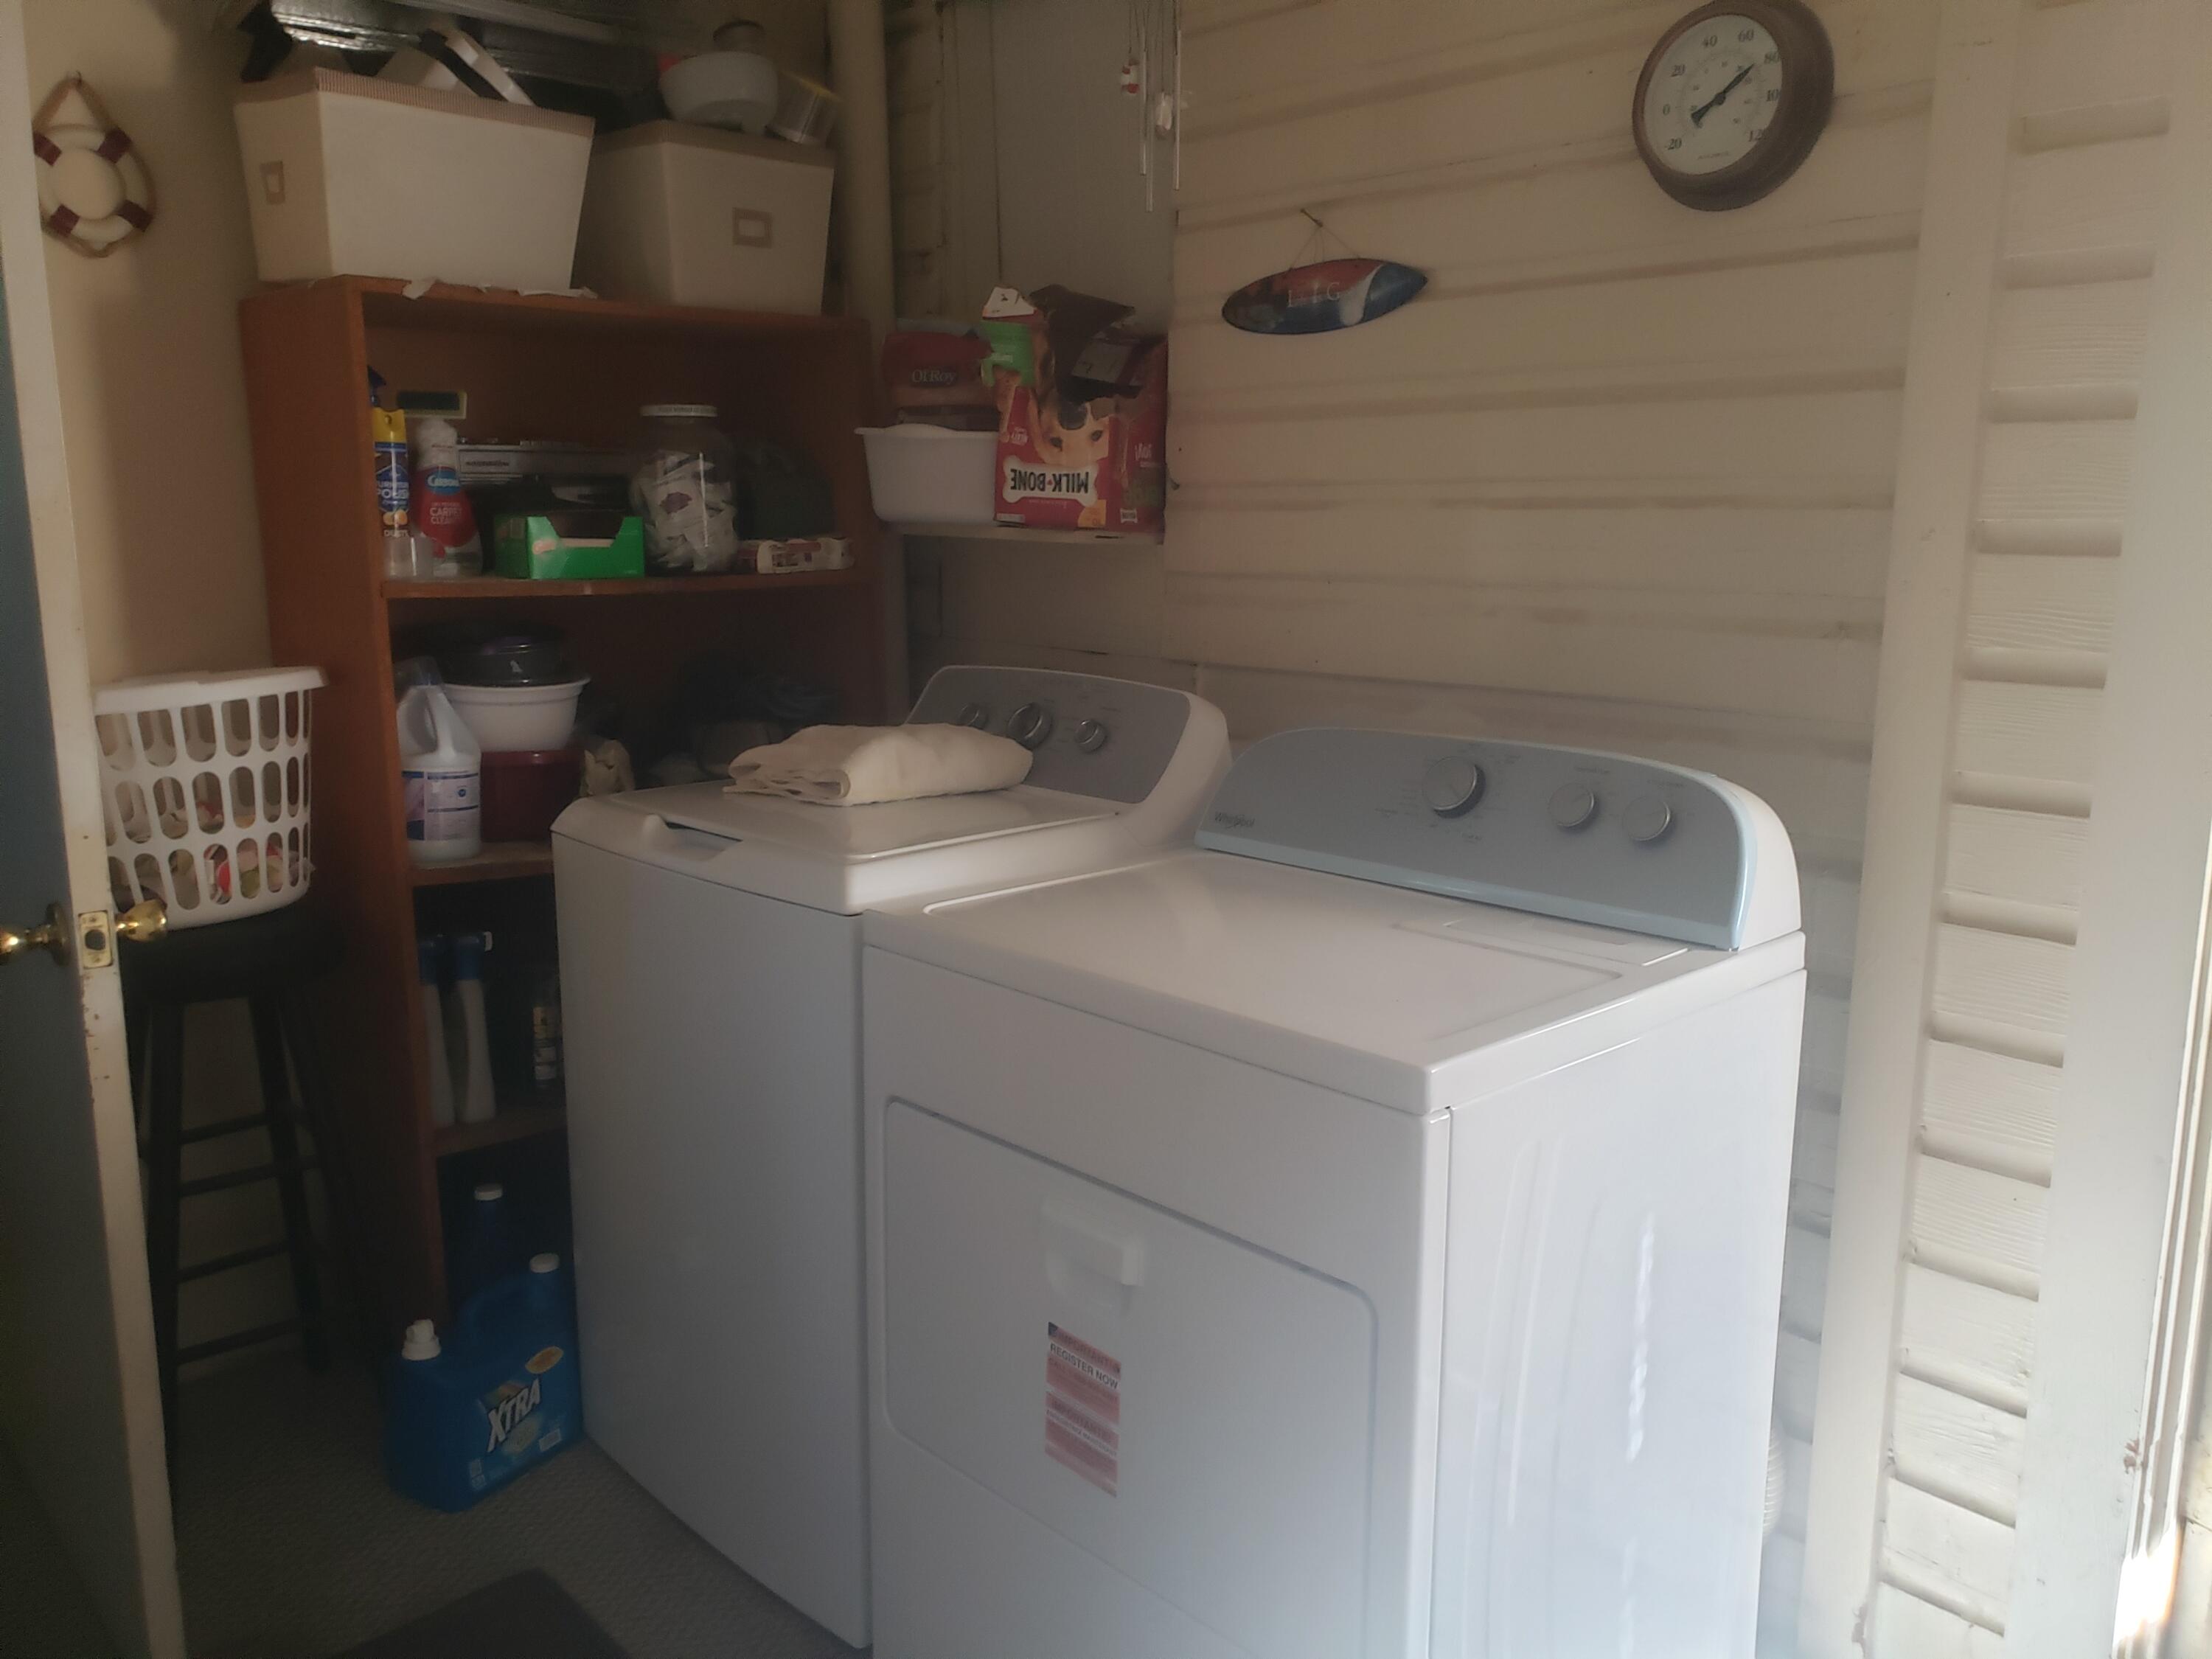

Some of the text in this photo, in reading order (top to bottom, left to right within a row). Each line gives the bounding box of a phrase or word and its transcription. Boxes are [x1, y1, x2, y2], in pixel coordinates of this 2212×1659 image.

[1738, 29, 1755, 42] 60
[1050, 1343, 1093, 1376] REGISTER
[1096, 1369, 1119, 1390] NOW
[487, 1377, 541, 1453] XTRA
